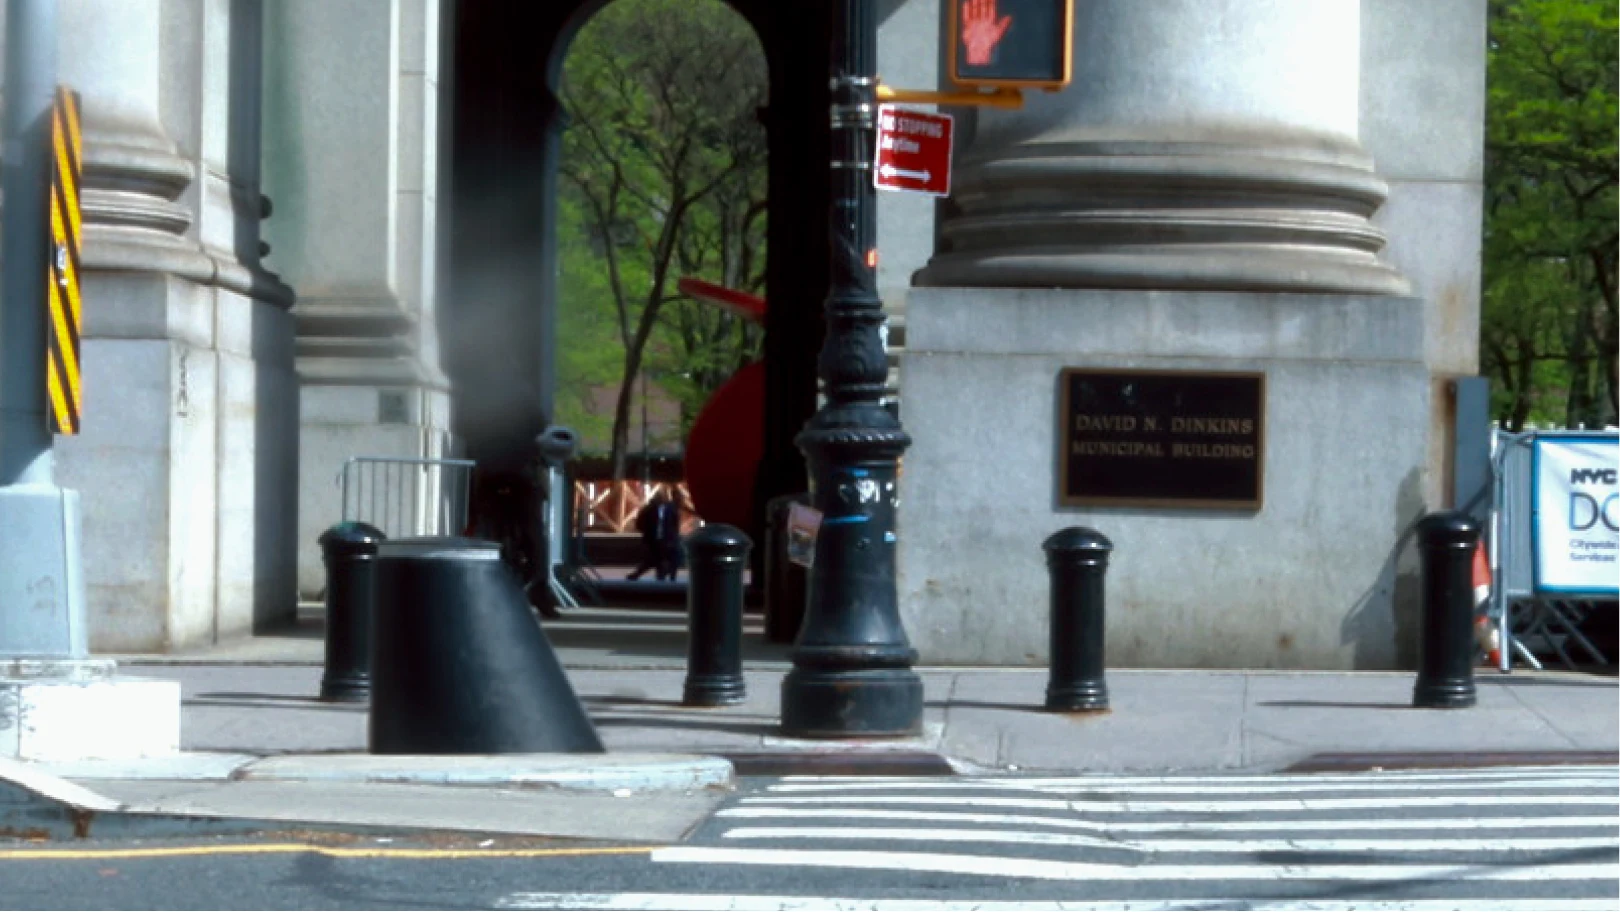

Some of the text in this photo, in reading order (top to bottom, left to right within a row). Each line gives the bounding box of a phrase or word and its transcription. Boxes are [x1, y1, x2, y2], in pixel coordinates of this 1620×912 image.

[897, 117, 943, 138] STOPPING
[1075, 414, 1254, 434] DAVID N. DINKINS
[1072, 441, 1254, 458] MUNICIPAL BUILDING
[1570, 468, 1617, 484] NYC
